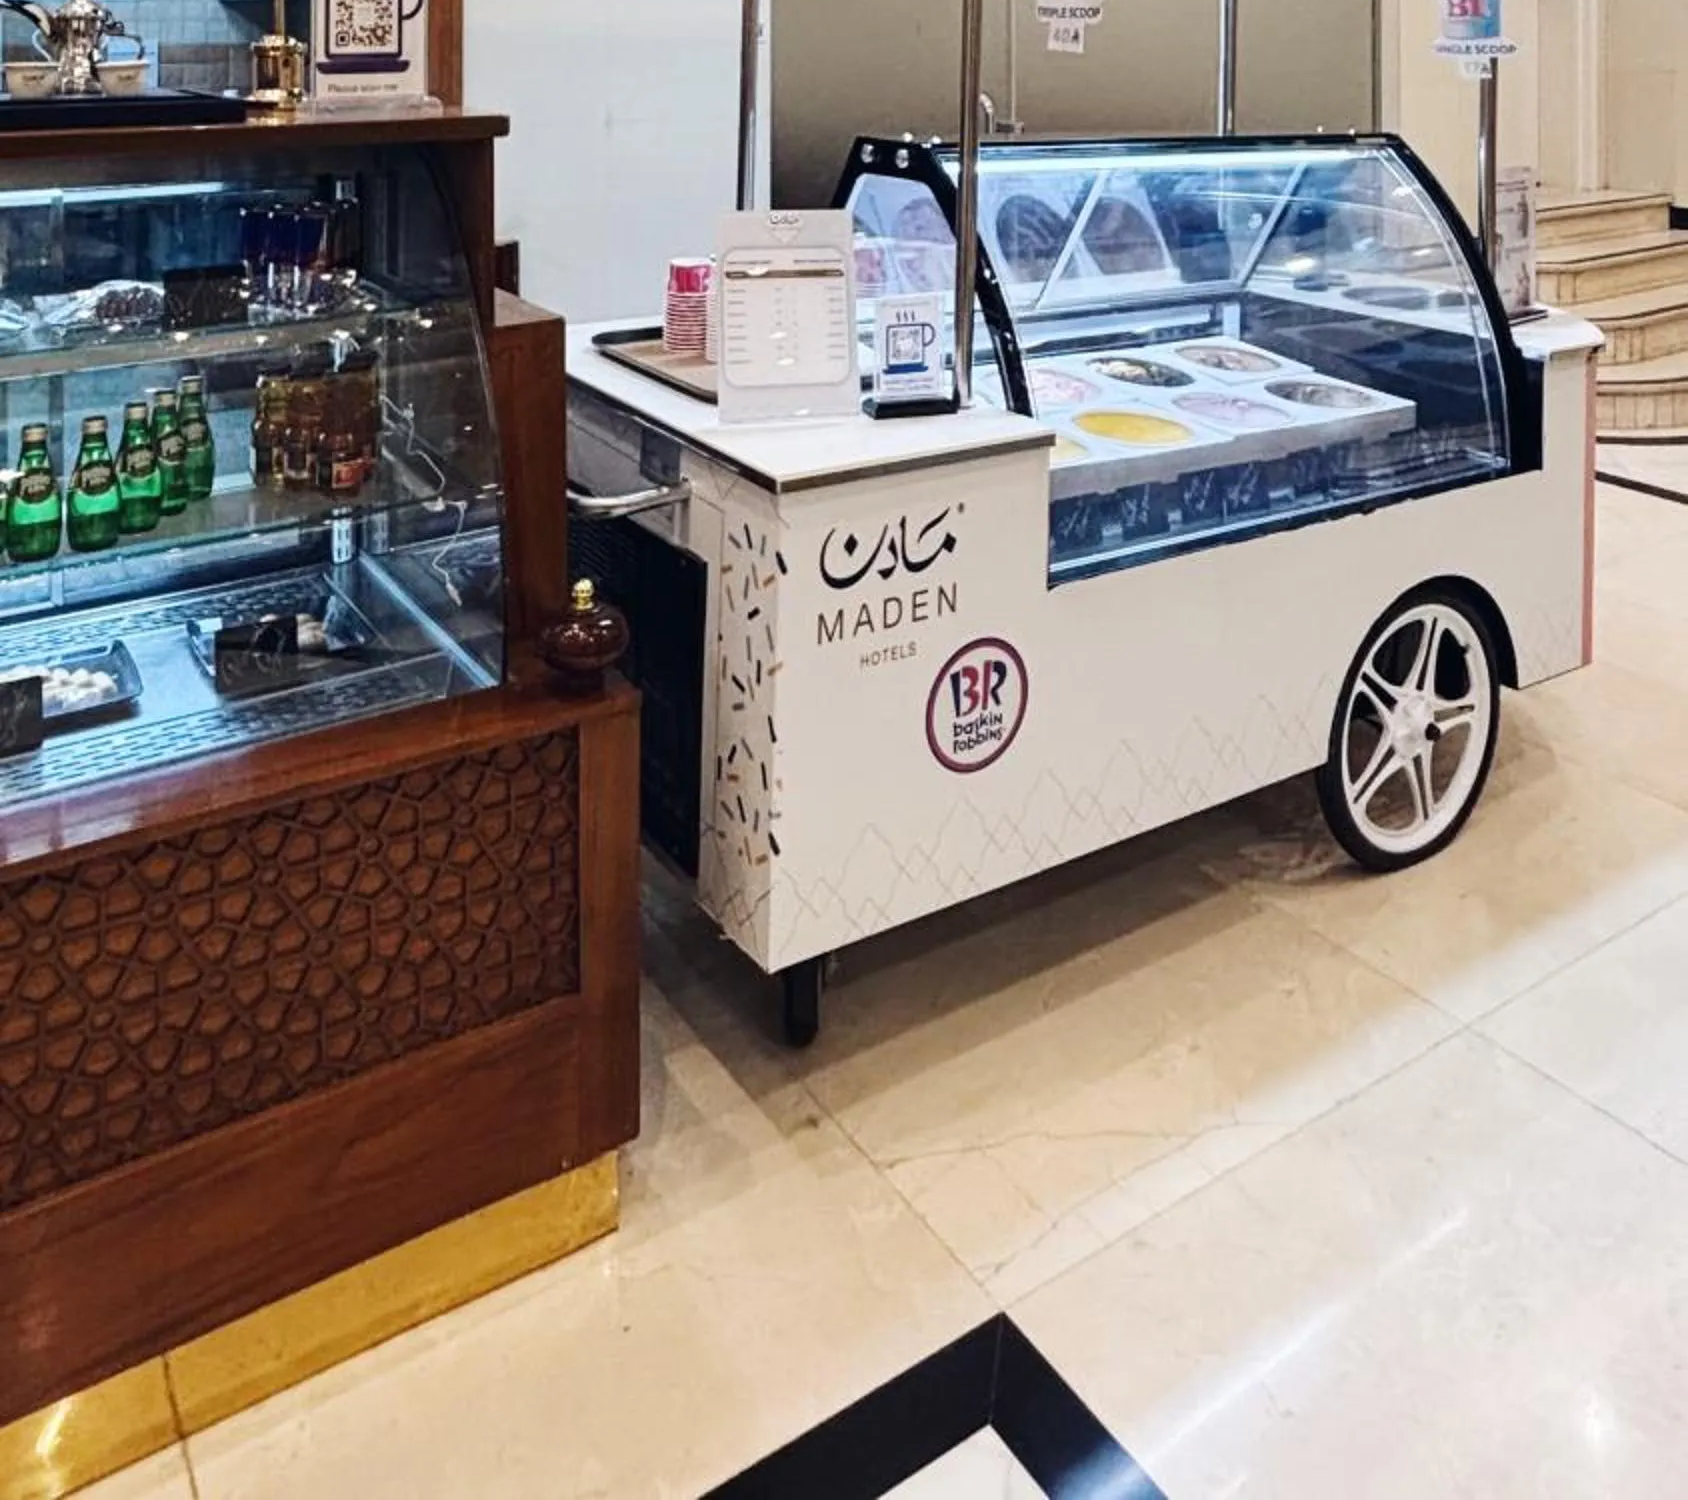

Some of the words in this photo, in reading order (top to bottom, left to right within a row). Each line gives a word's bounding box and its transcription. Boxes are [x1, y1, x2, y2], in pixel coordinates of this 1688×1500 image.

[816, 581, 958, 646] MADEN
[859, 641, 918, 669] HOTELS
[950, 659, 1007, 718] BR
